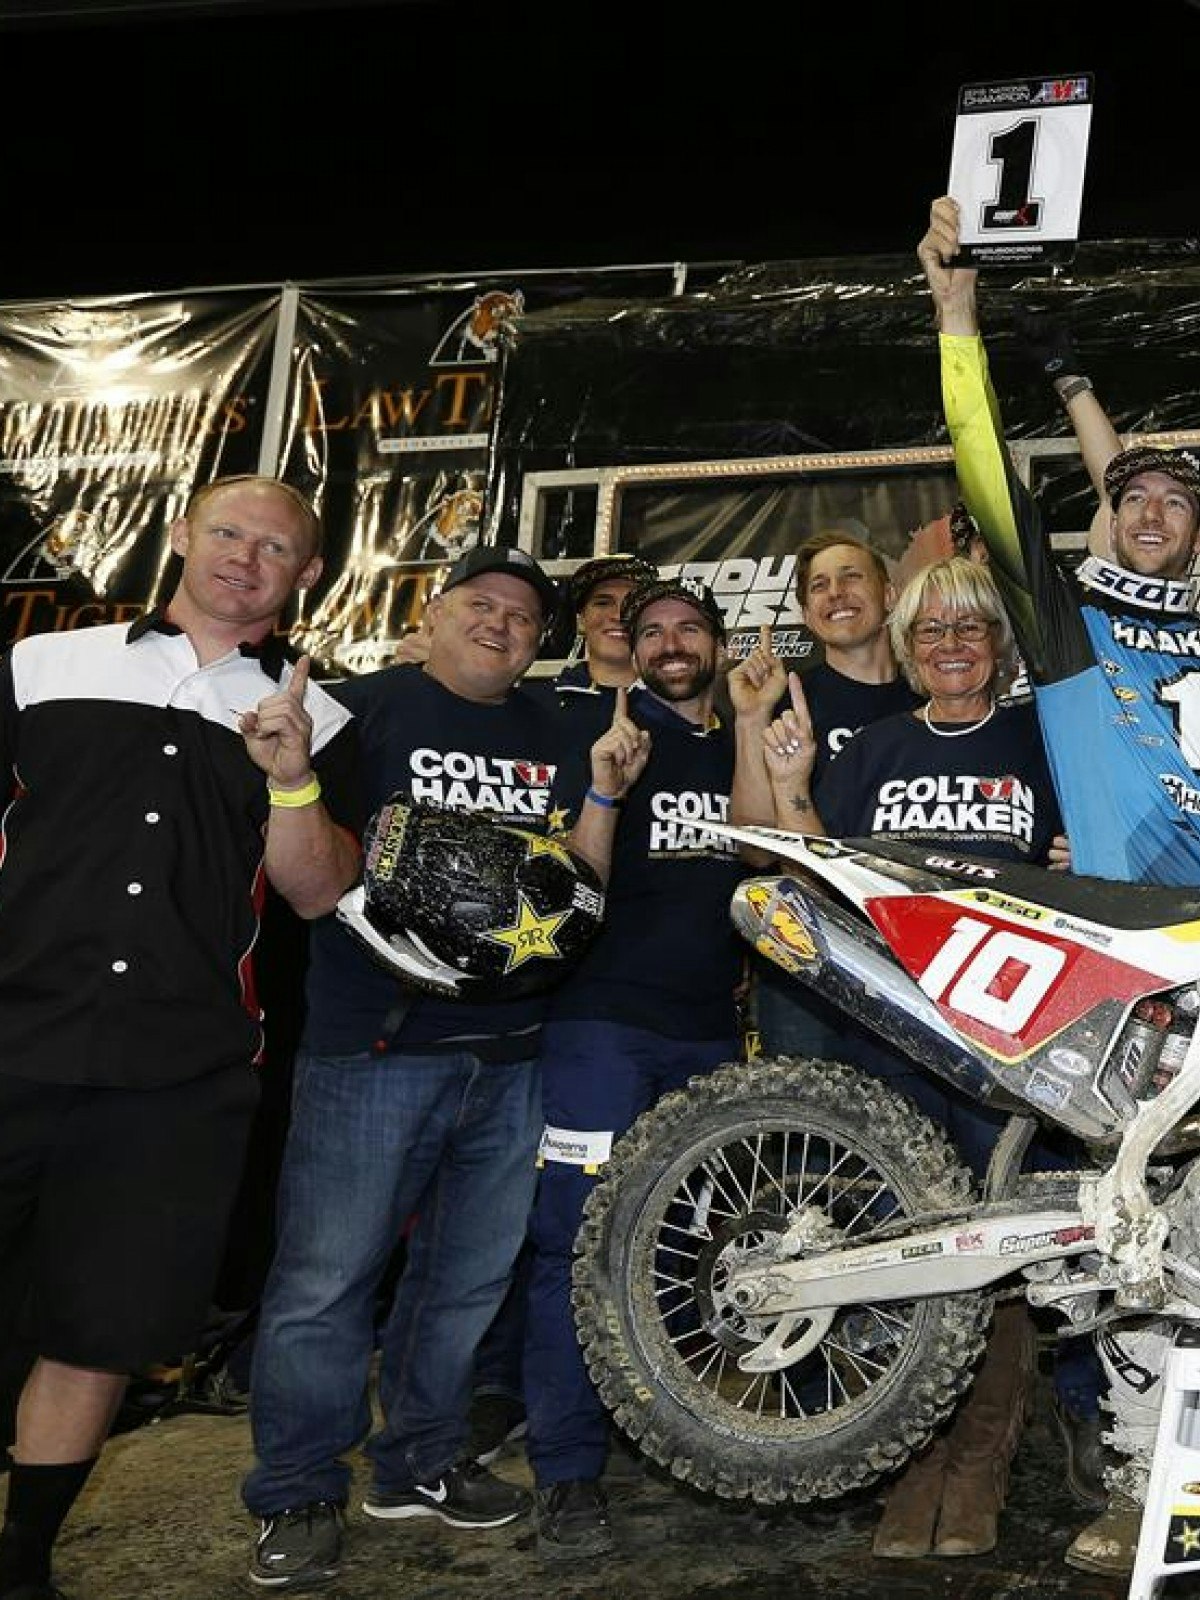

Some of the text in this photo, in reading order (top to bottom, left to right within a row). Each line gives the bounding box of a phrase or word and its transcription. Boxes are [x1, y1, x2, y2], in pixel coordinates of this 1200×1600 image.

[981, 115, 1045, 234] 1
[872, 804, 1034, 842] HAAKER
[917, 916, 1067, 1034] 10
